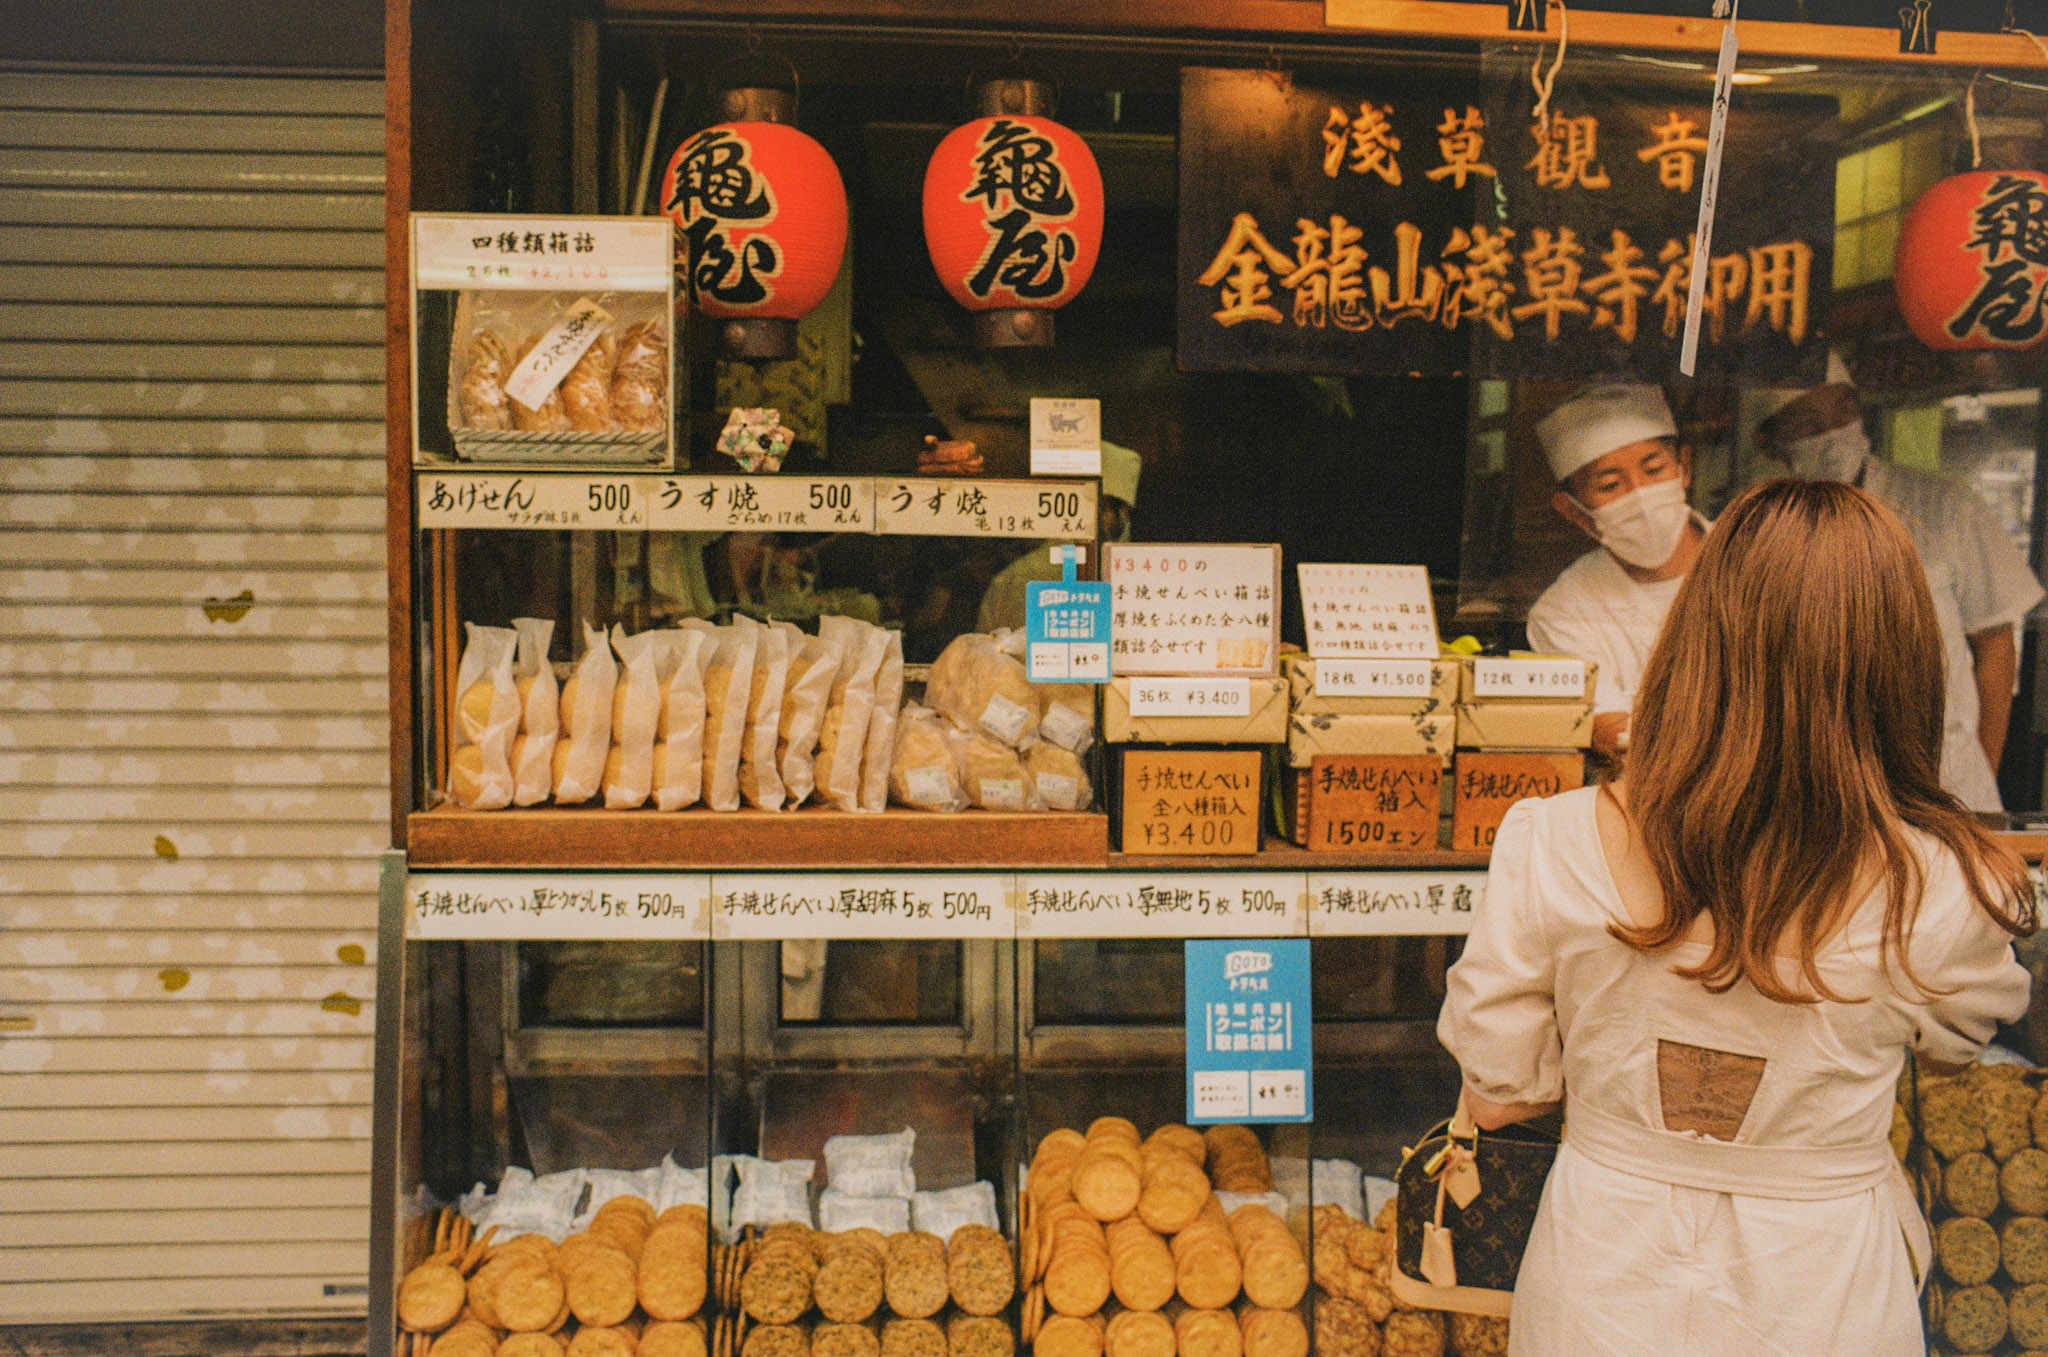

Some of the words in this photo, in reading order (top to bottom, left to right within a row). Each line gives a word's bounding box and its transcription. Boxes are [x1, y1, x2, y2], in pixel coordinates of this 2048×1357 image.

[472, 231, 595, 255] 四種類箱詰
[428, 479, 537, 513] あげせん
[588, 484, 631, 512] 500
[661, 480, 759, 512] うす焼
[810, 484, 852, 510] 500
[892, 485, 988, 516] うす焼
[1038, 493, 1079, 518] 500
[1137, 765, 1250, 792] 手焼せんべい
[1152, 796, 1246, 818] 全八種箱入
[637, 892, 685, 919] 500円
[943, 891, 991, 920] 500円
[1242, 889, 1286, 916] 500円
[1215, 1015, 1284, 1033] クーポン
